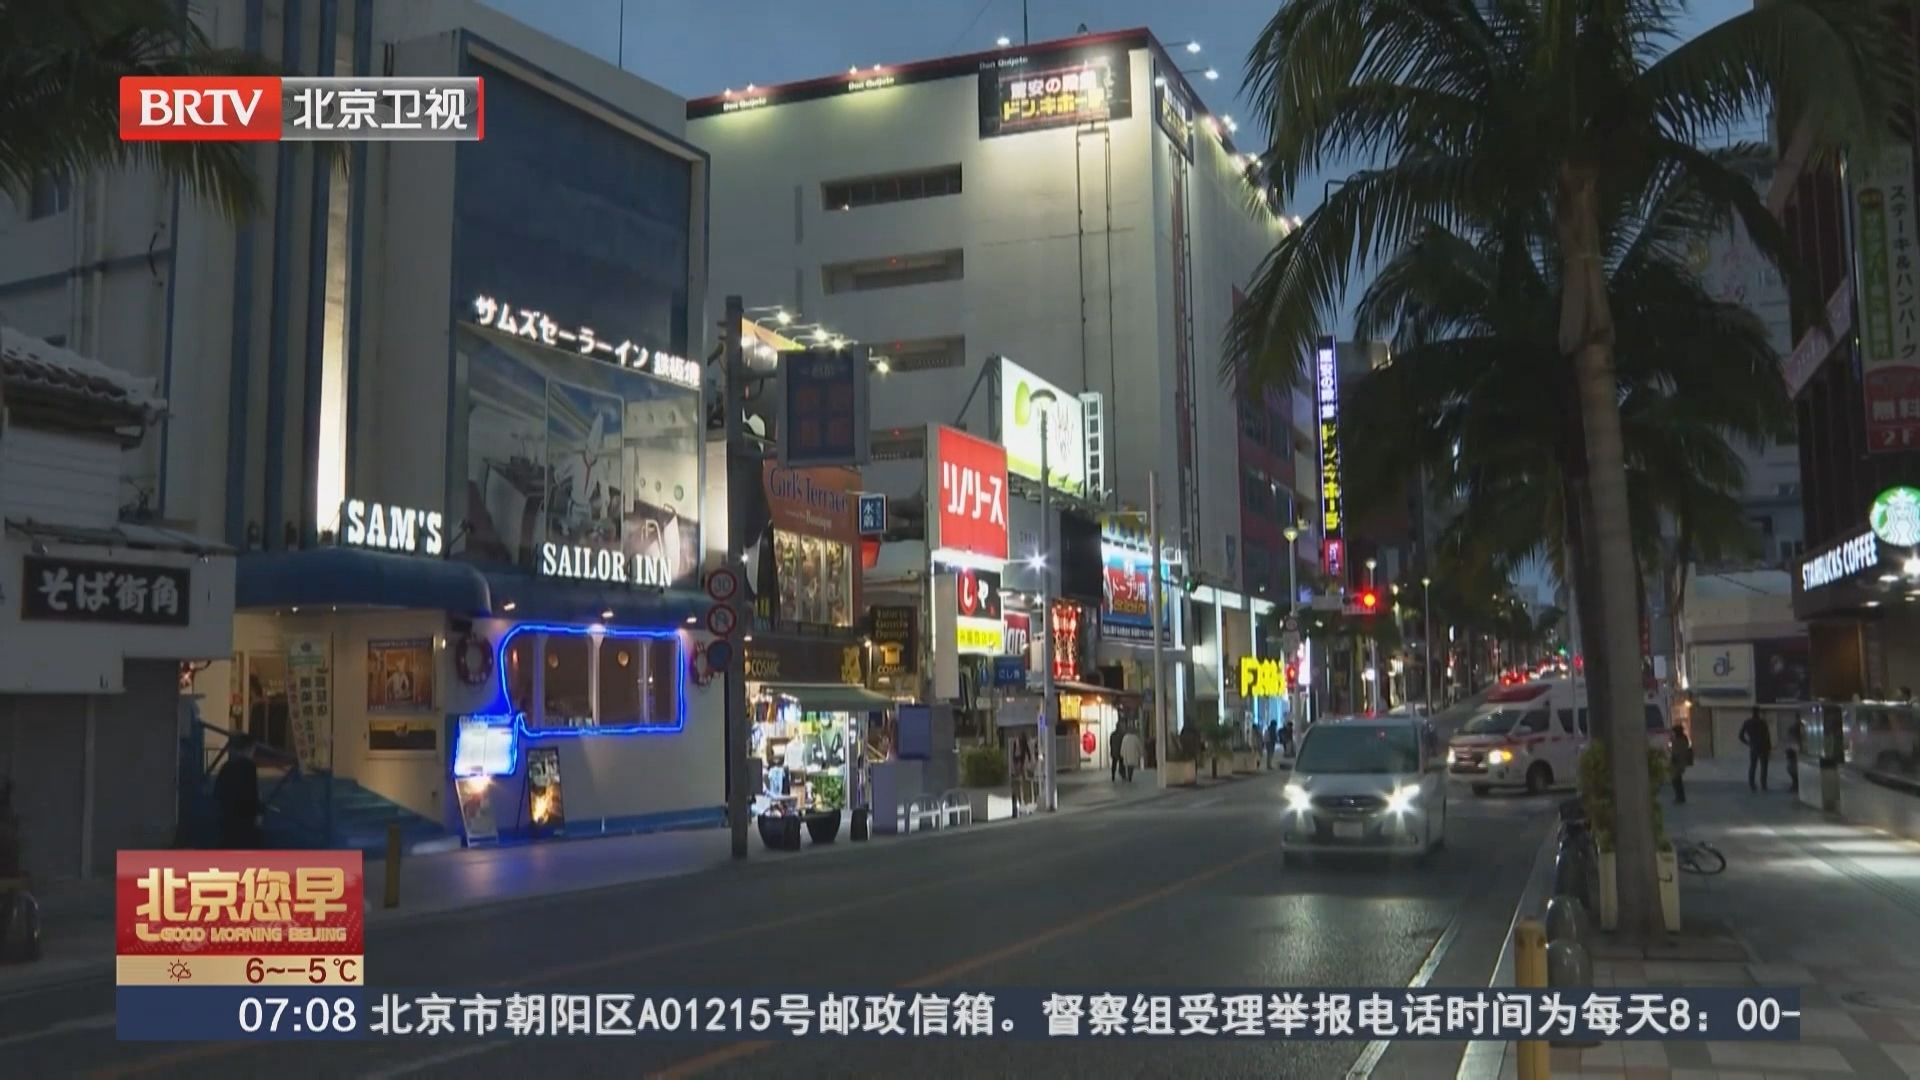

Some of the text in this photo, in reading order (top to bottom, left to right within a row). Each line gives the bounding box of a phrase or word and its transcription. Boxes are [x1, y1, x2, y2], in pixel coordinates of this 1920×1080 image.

[979, 56, 1029, 70] Don Quijote
[475, 293, 649, 368] サムズセーラーイン
[347, 500, 442, 555] SAM'S
[543, 541, 673, 587] SAILOR INN
[714, 577, 731, 593] 30
[1802, 530, 1878, 592] STARBUCKS COFFEE
[38, 566, 179, 616] そば街角
